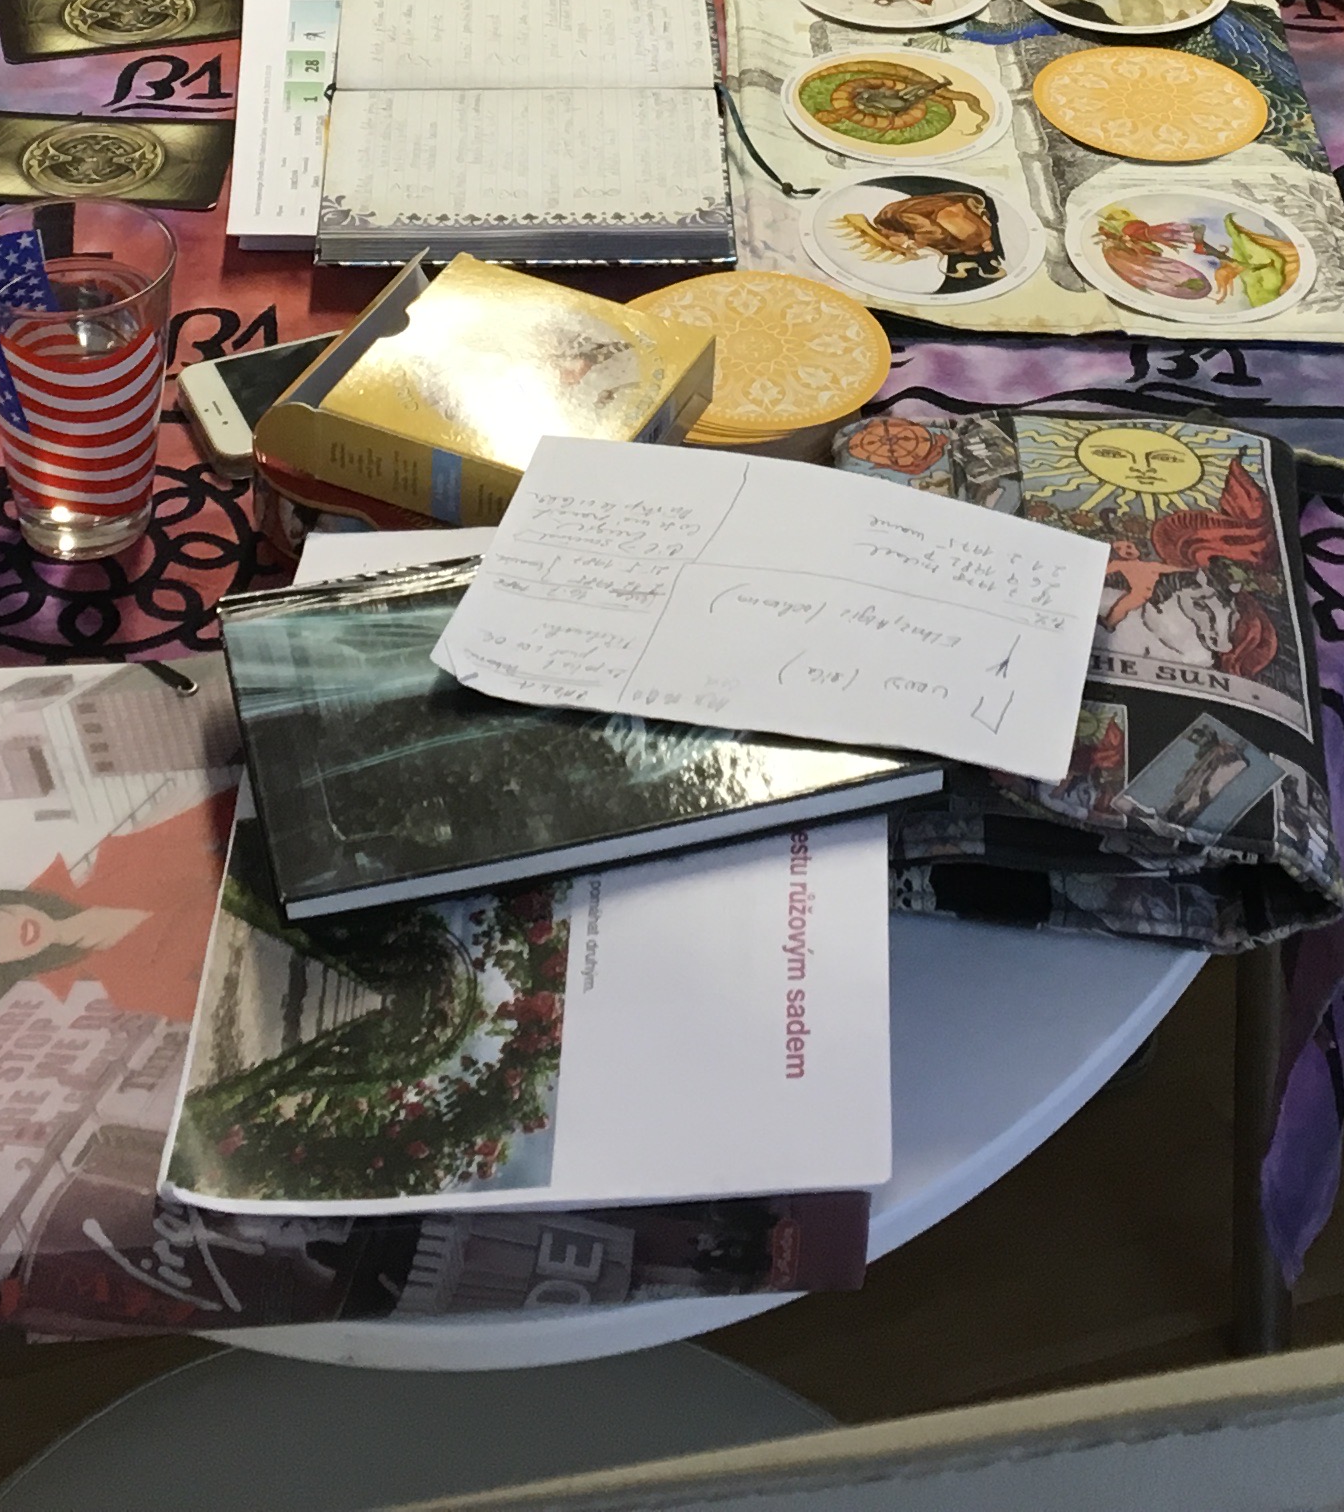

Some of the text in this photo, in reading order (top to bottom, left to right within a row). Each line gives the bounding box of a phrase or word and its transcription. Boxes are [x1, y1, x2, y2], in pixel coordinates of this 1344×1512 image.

[304, 58, 320, 73] 28
[1090, 655, 1231, 693] HE SUN
[782, 826, 817, 1080] estu růžovým sadem
